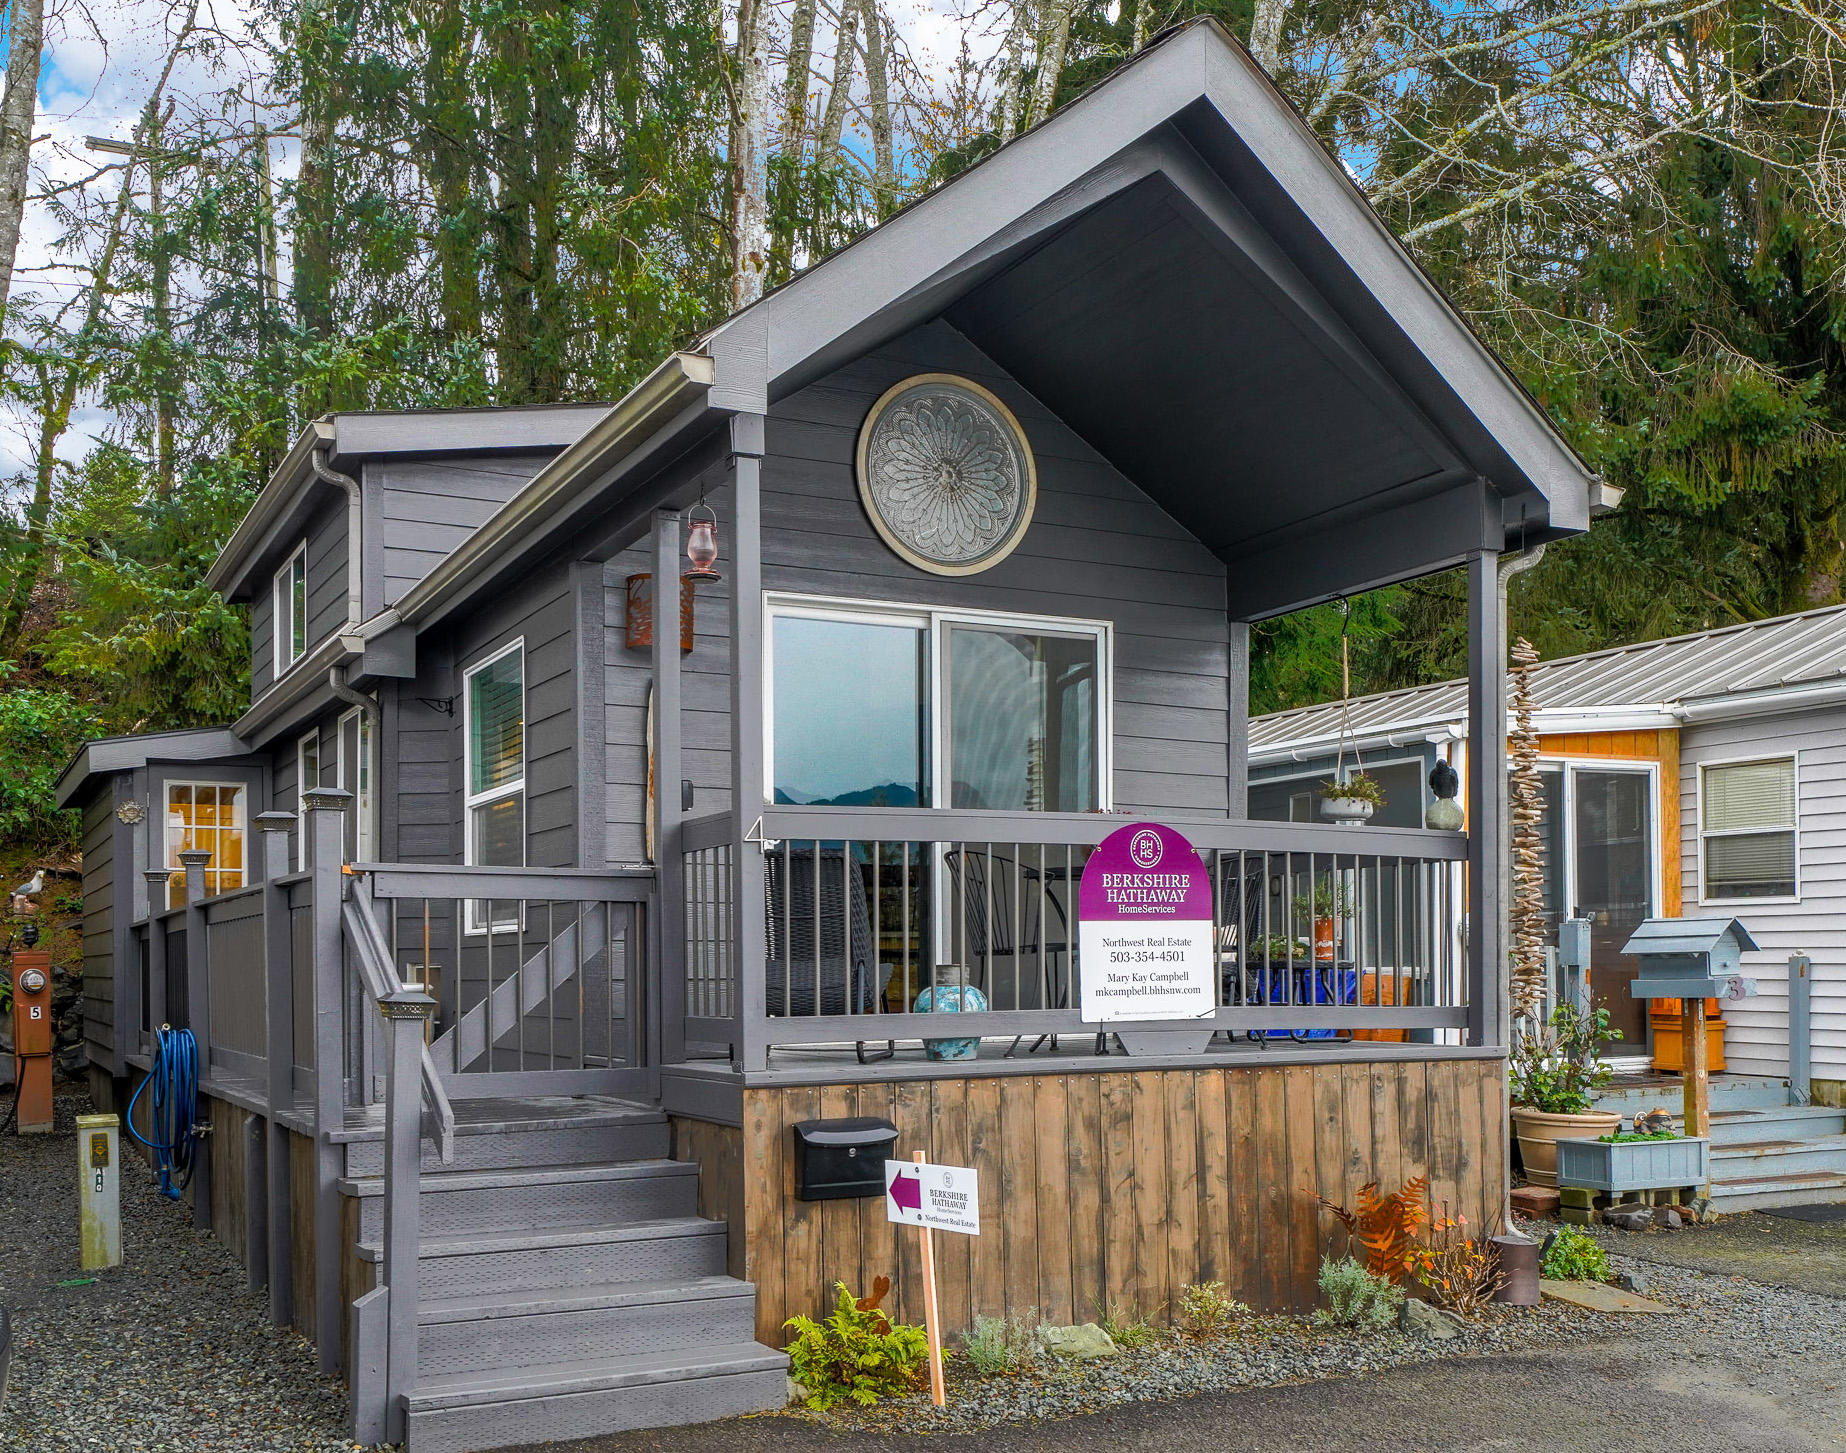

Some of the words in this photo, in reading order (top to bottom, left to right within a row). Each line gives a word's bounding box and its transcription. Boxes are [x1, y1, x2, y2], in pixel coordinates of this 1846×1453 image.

[744, 815, 767, 853] 4
[1140, 840, 1153, 849] BH
[1140, 849, 1153, 858] HS
[1102, 874, 1190, 888] BERKSHIRE
[1107, 889, 1187, 903] HATHAWAY
[1118, 905, 1176, 914] HomeServices
[1102, 938, 1145, 948] Northwest
[1147, 938, 1165, 947] Real
[1167, 937, 1192, 947] Estate
[1110, 951, 1185, 963] 503-354-4501
[1107, 973, 1130, 985] Mary
[1132, 973, 1147, 984] Kay
[1149, 972, 1189, 984] Campbell
[1095, 986, 1201, 998] mkcampbell.bhhsnw.com
[1727, 976, 1746, 1001] 3
[32, 1007, 40, 1018] 5
[929, 1189, 968, 1201] BERKSHIRE
[931, 1198, 967, 1210] HATHAWAY
[925, 1214, 949, 1224] Northwest
[949, 1218, 961, 1226] Real
